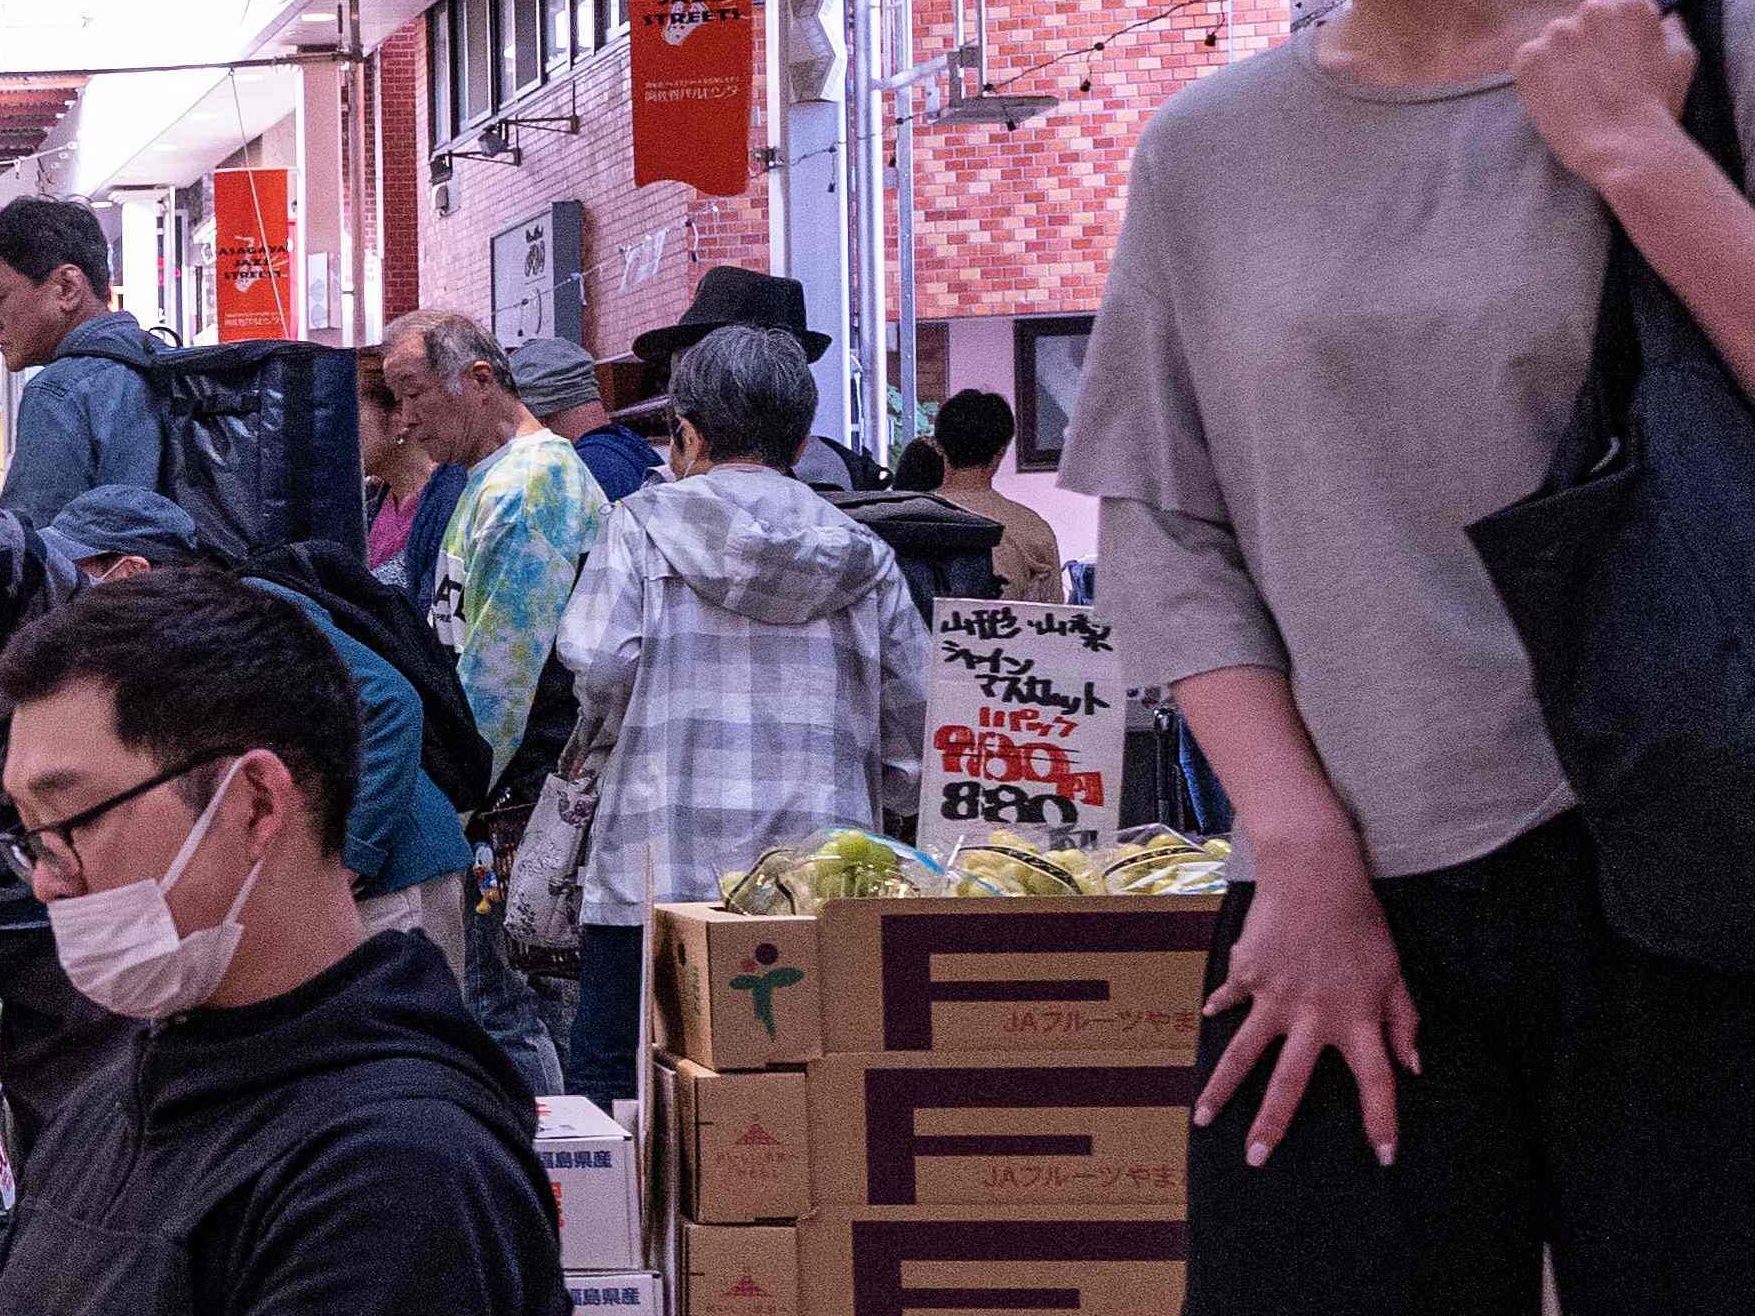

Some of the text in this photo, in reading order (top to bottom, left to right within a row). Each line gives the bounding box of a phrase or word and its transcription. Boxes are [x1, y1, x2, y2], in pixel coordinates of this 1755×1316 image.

[643, 10, 741, 26] STREETS
[941, 640, 1035, 675] シャイン
[974, 674, 1111, 716] マスカット
[941, 780, 1079, 825] 880
